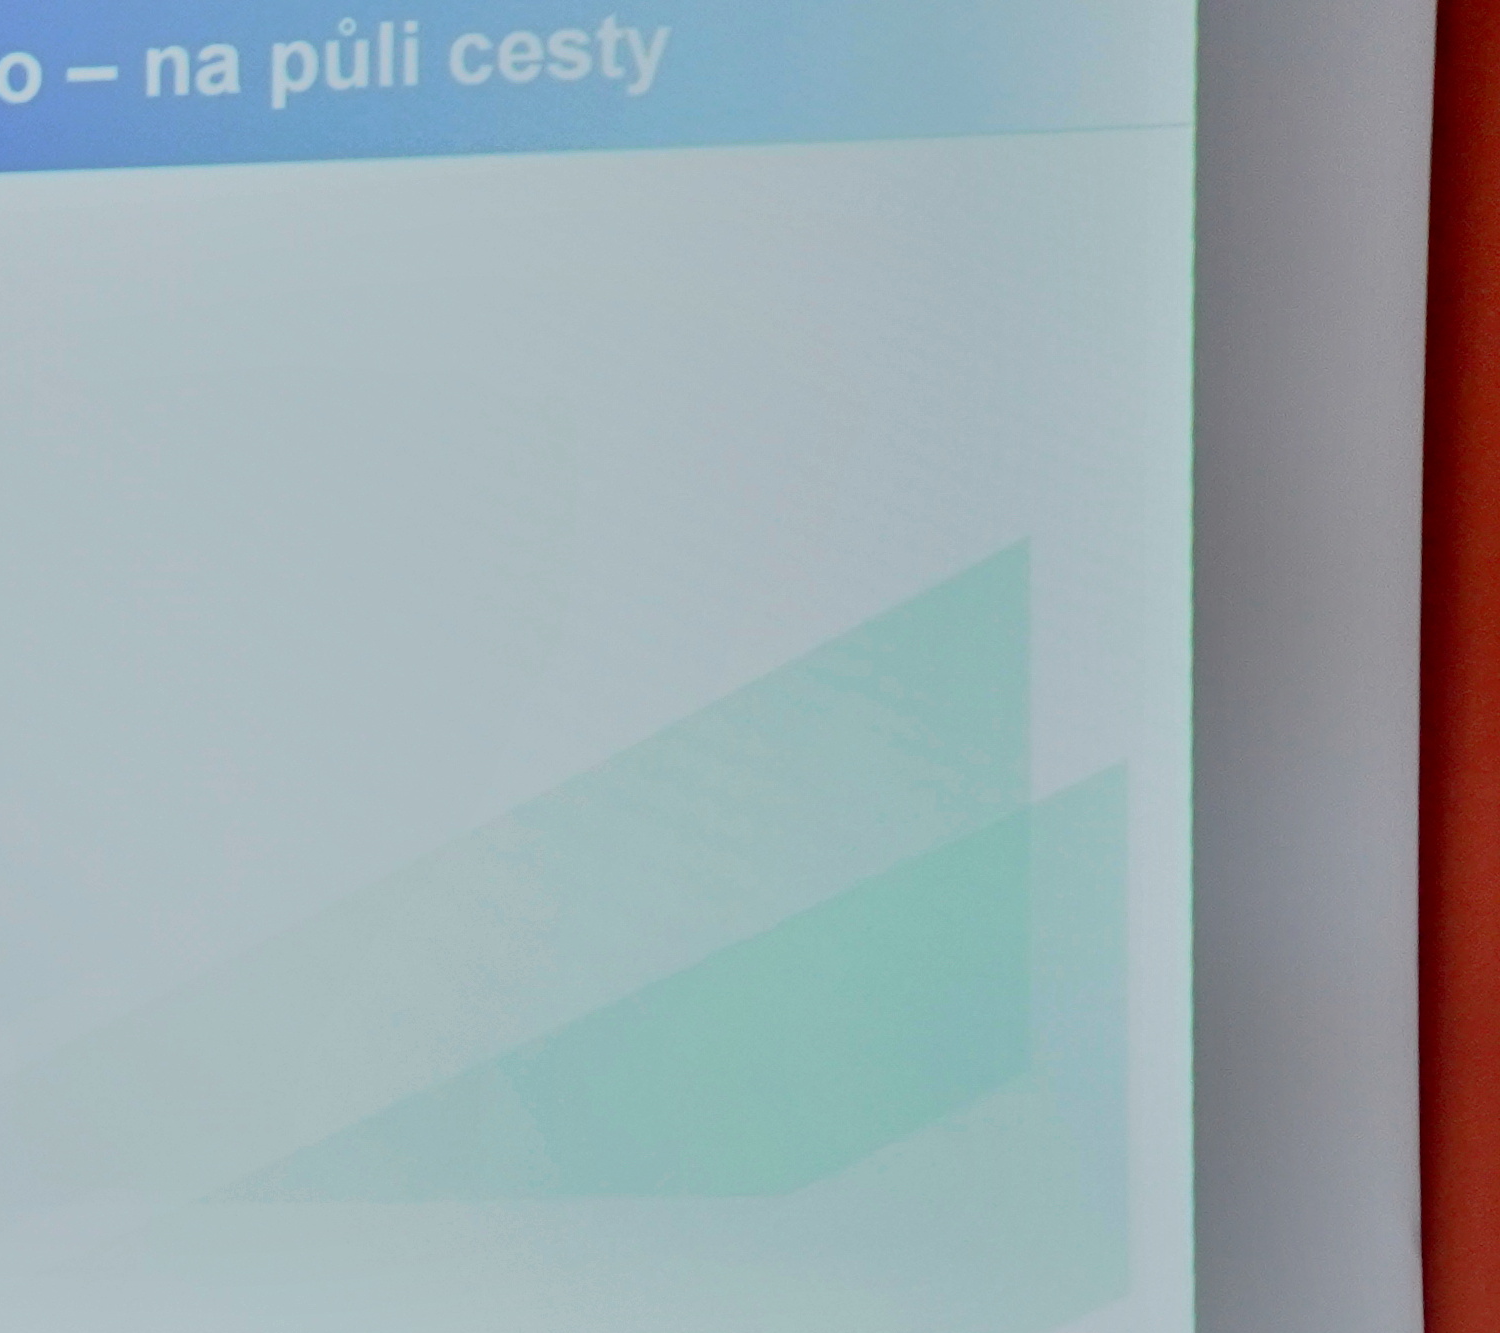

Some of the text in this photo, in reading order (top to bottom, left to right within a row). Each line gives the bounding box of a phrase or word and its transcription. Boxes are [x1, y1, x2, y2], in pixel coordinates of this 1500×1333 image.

[146, 38, 241, 99] na
[270, 16, 421, 109] půli
[448, 14, 670, 96] cesty
